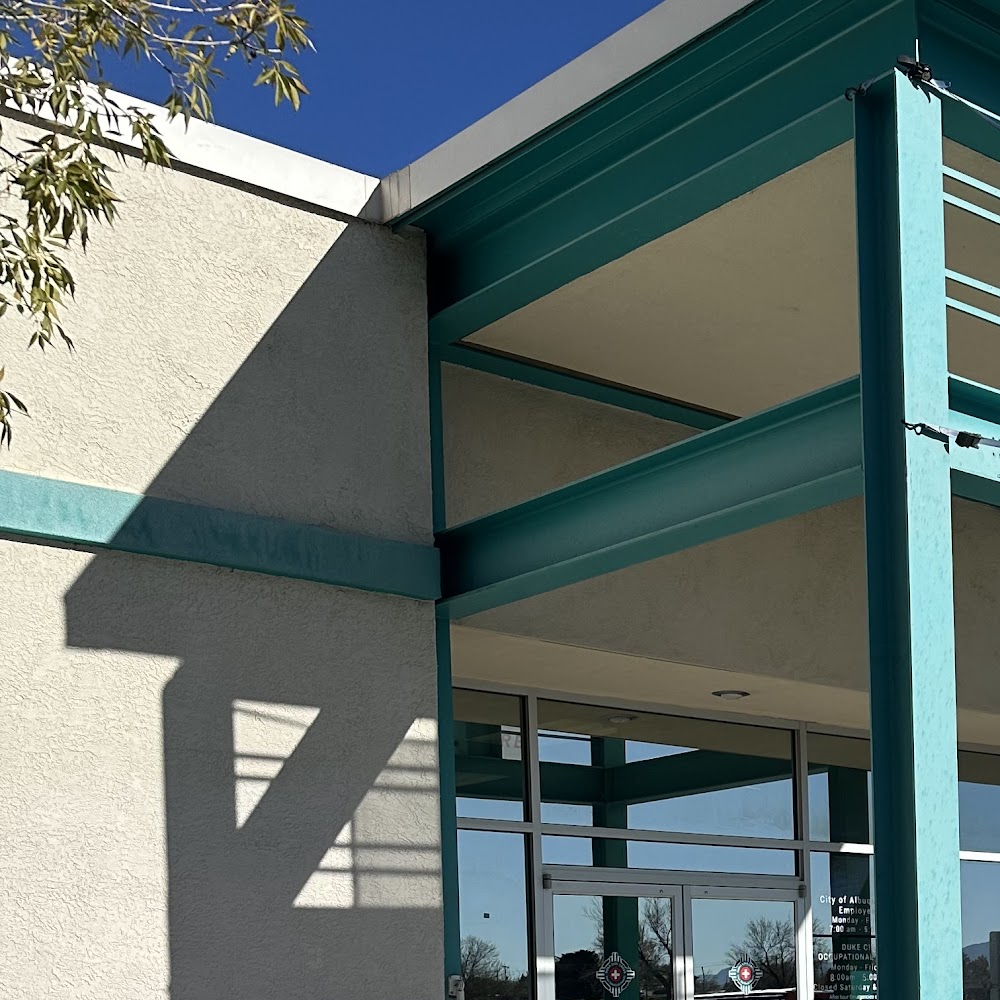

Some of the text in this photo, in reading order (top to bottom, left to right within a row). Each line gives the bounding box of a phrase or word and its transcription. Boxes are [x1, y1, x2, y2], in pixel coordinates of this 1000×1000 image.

[819, 895, 836, 905] City
[838, 895, 846, 904] of
[838, 906, 870, 915] Employe
[832, 916, 858, 925] Monday
[841, 943, 860, 951] DUKE
[817, 952, 875, 961] OCCUPATIONAL
[831, 964, 858, 973] Monday
[813, 983, 837, 991] Closed
[839, 983, 870, 992] Saturday
